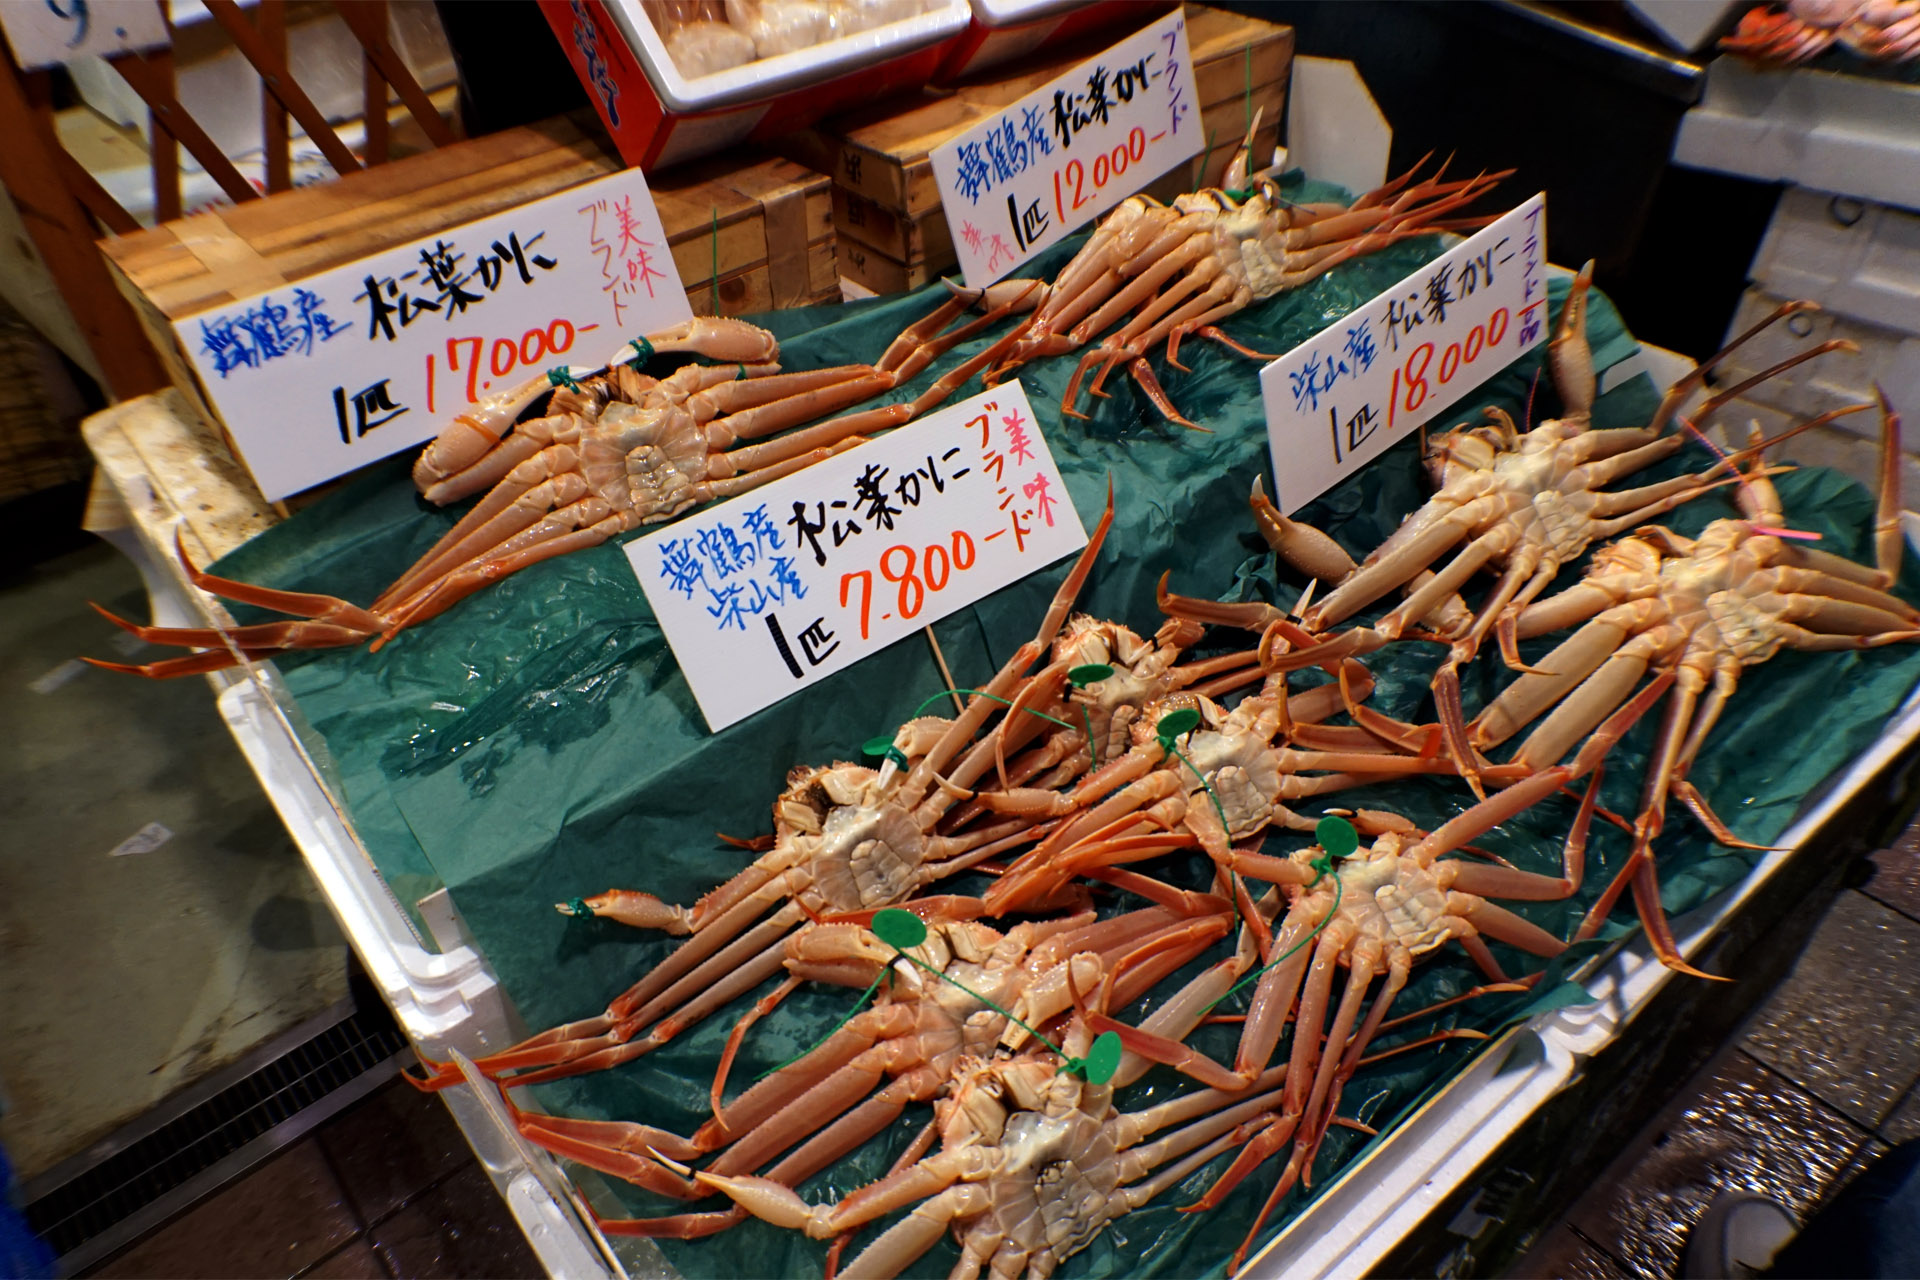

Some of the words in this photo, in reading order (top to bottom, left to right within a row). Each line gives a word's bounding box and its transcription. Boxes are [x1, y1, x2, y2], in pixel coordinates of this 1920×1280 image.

[1049, 52, 1162, 149] 松葉かに
[614, 194, 667, 299] 美味
[1006, 192, 1050, 253] 1匹
[352, 230, 559, 342] 松葉かに
[1380, 236, 1517, 352] 松葉かに
[332, 378, 410, 445] 1匹
[1329, 402, 1380, 465] 1匹
[787, 447, 972, 567] 松葉かに
[1002, 408, 1058, 528] 美味
[764, 612, 842, 680] 1匹
